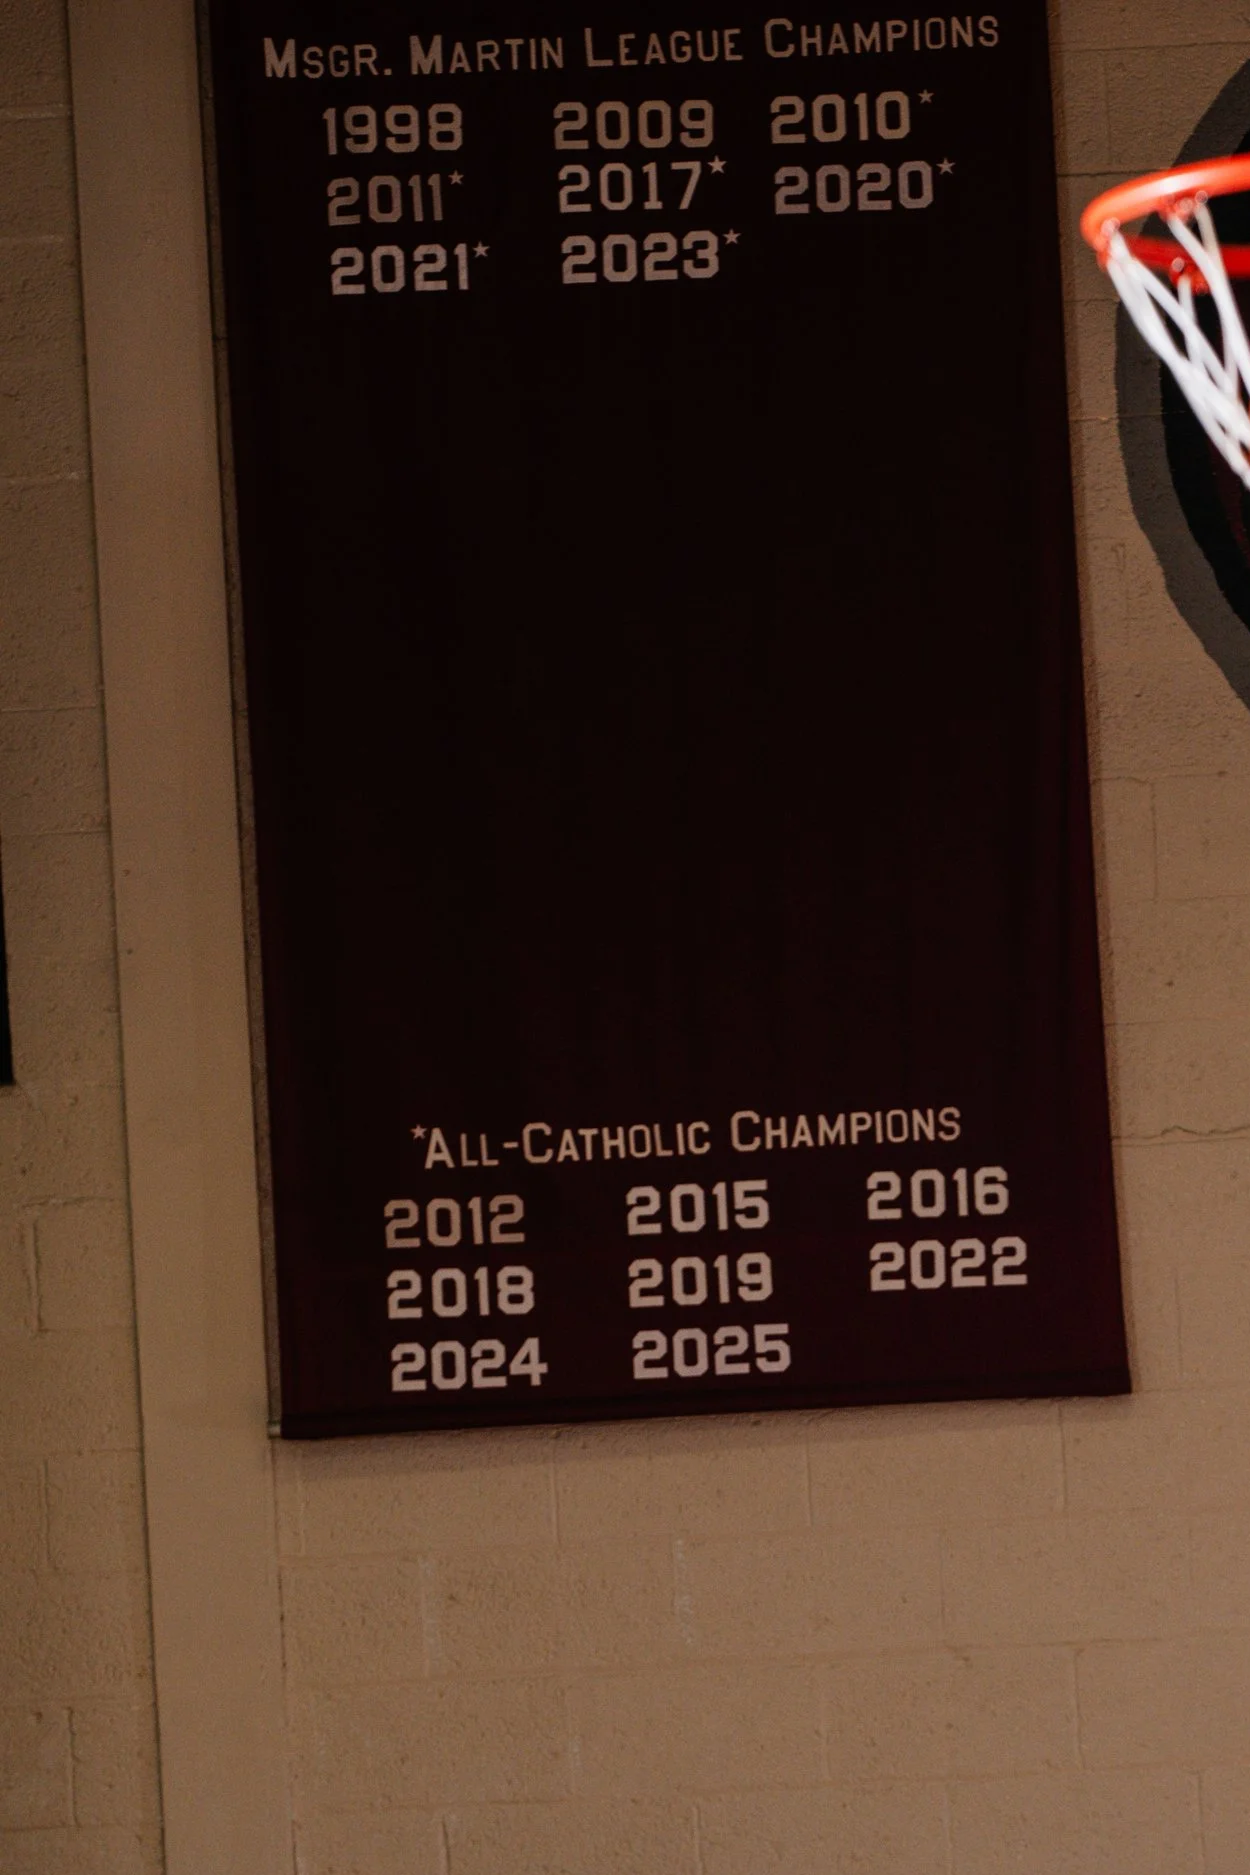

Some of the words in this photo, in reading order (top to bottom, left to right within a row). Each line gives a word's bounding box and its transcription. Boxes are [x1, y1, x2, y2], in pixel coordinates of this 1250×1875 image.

[263, 37, 392, 79] MSGR.
[409, 34, 564, 75] MARTIN
[584, 28, 743, 67] LEAGUE
[764, 15, 1000, 58] CHAMPIONS
[323, 103, 463, 156] 1998
[553, 99, 714, 150] 2009
[730, 1106, 961, 1152] CHAMPIONS
[384, 1194, 525, 1249] 2012
[625, 1179, 770, 1236] 2015
[866, 1165, 1009, 1221] 2016
[387, 1265, 535, 1318] 2018
[628, 1251, 774, 1308] 2019
[869, 1236, 1028, 1292] 2022
[391, 1337, 549, 1392] 2024
[632, 1323, 792, 1380] 2025
